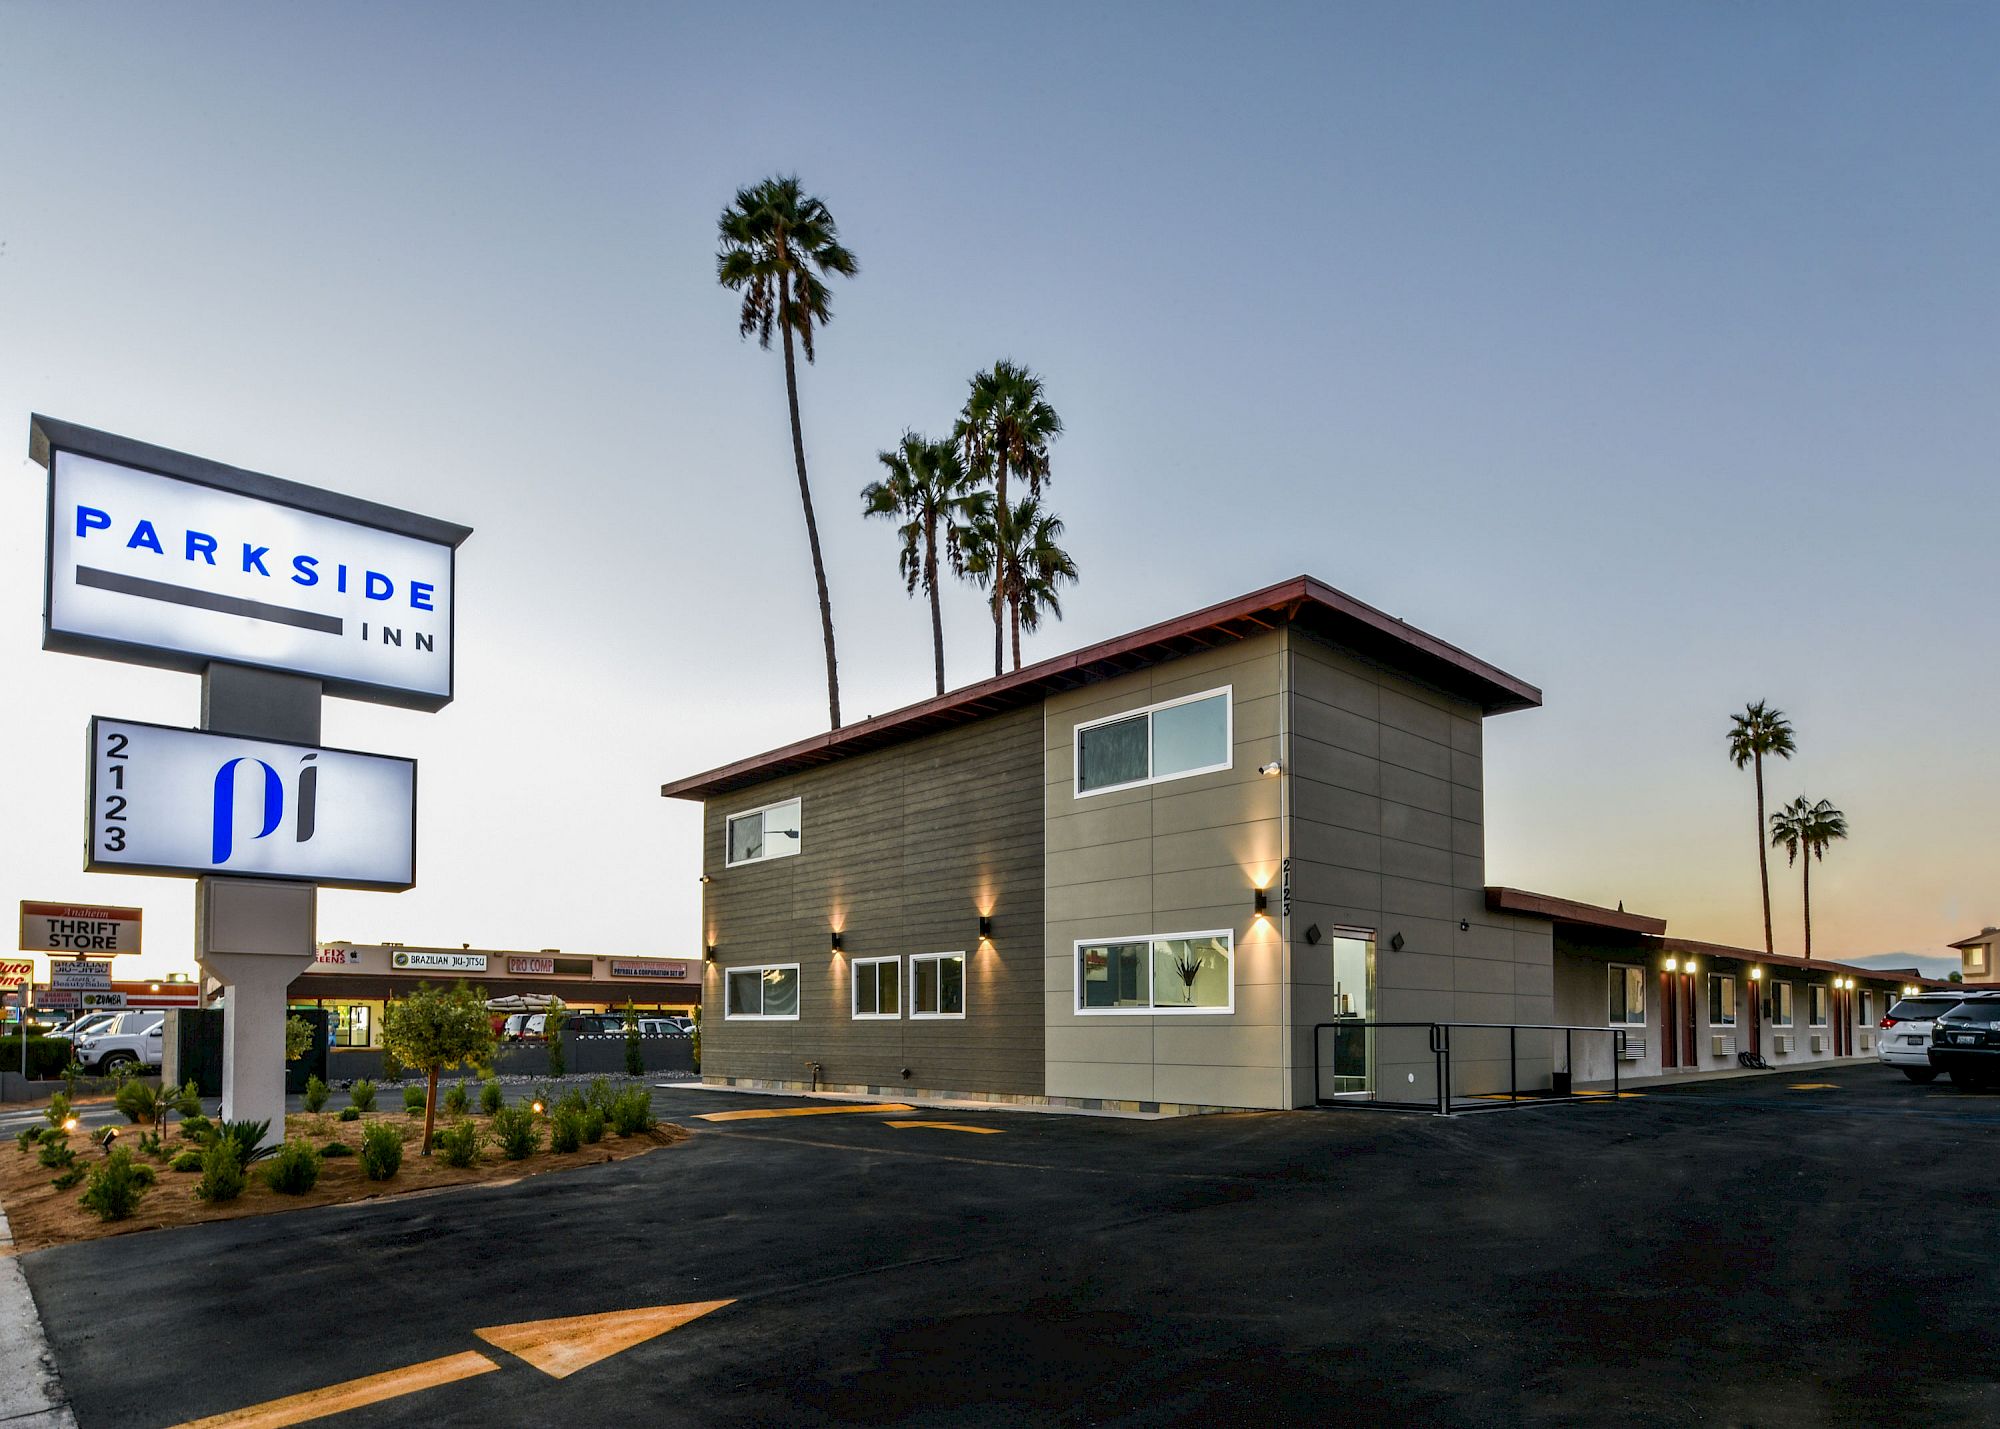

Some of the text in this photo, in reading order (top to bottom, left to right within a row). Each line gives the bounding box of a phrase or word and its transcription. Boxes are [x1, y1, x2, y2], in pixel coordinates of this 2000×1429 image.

[76, 505, 435, 611] PARKSIDE
[362, 622, 434, 652] INN
[104, 733, 129, 852] 2123
[1283, 859, 1291, 917] 2123
[63, 907, 109, 918] Anaheim
[47, 919, 121, 936] THRIFT
[49, 934, 117, 950] STORE
[324, 949, 345, 957] FIX
[410, 955, 485, 967] BRAZILIAN JIU-JITSU
[511, 959, 553, 972] PRO COMP
